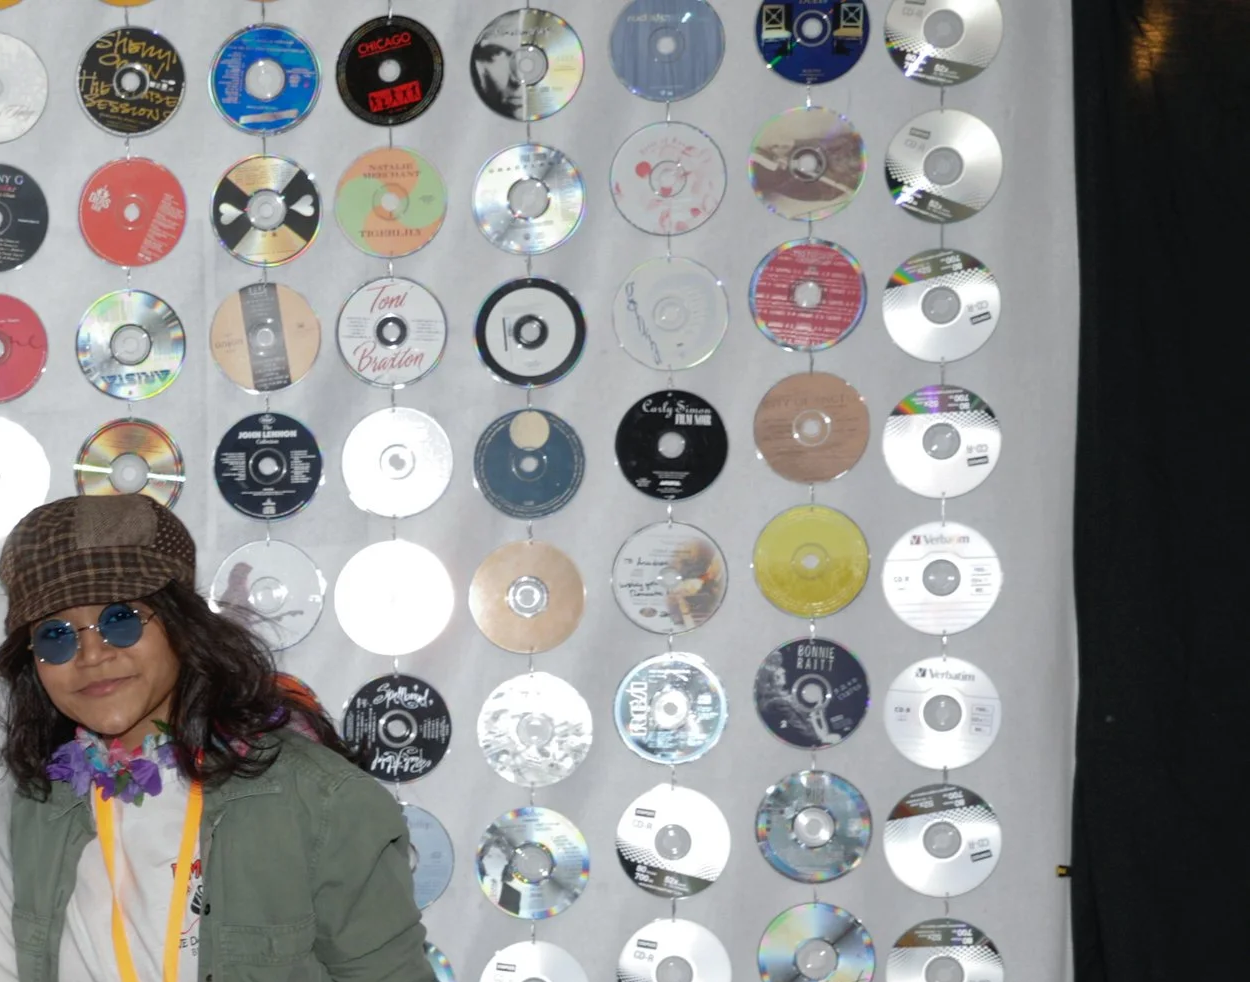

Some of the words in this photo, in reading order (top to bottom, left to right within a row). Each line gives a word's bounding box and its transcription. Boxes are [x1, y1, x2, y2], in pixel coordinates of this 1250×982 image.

[356, 31, 412, 56] CHICAGO
[13, 174, 24, 185] G
[366, 285, 412, 314] Toni
[352, 345, 425, 373] Braxton
[100, 369, 171, 385] ARISTA
[641, 398, 674, 419] Carly
[674, 399, 713, 415] Simon
[238, 430, 262, 439] JOHN
[262, 430, 298, 439] LENNON
[924, 534, 971, 546] Verbatim
[797, 644, 835, 659] BONNIE
[796, 657, 835, 672] RAITT
[928, 669, 976, 682] Verbatim
